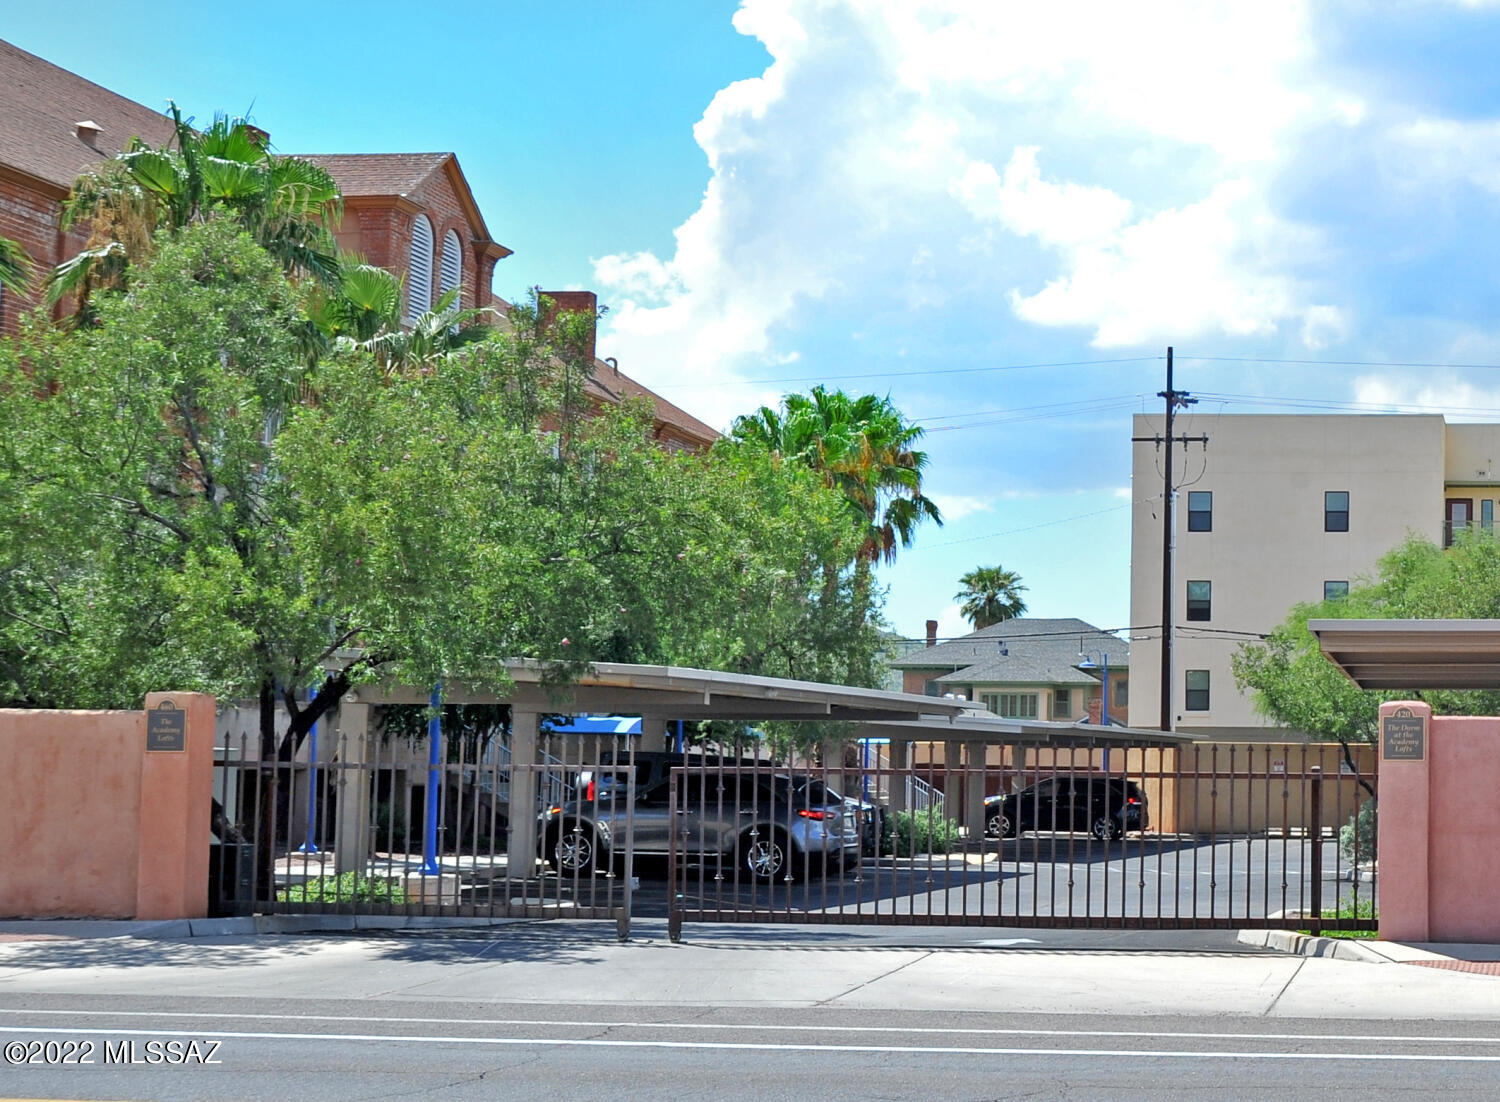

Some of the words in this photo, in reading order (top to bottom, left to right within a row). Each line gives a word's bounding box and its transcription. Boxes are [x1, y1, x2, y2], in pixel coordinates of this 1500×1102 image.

[1396, 710, 1411, 718] 420
[1388, 739, 1420, 747] Academy
[1395, 745, 1412, 753] Lofts
